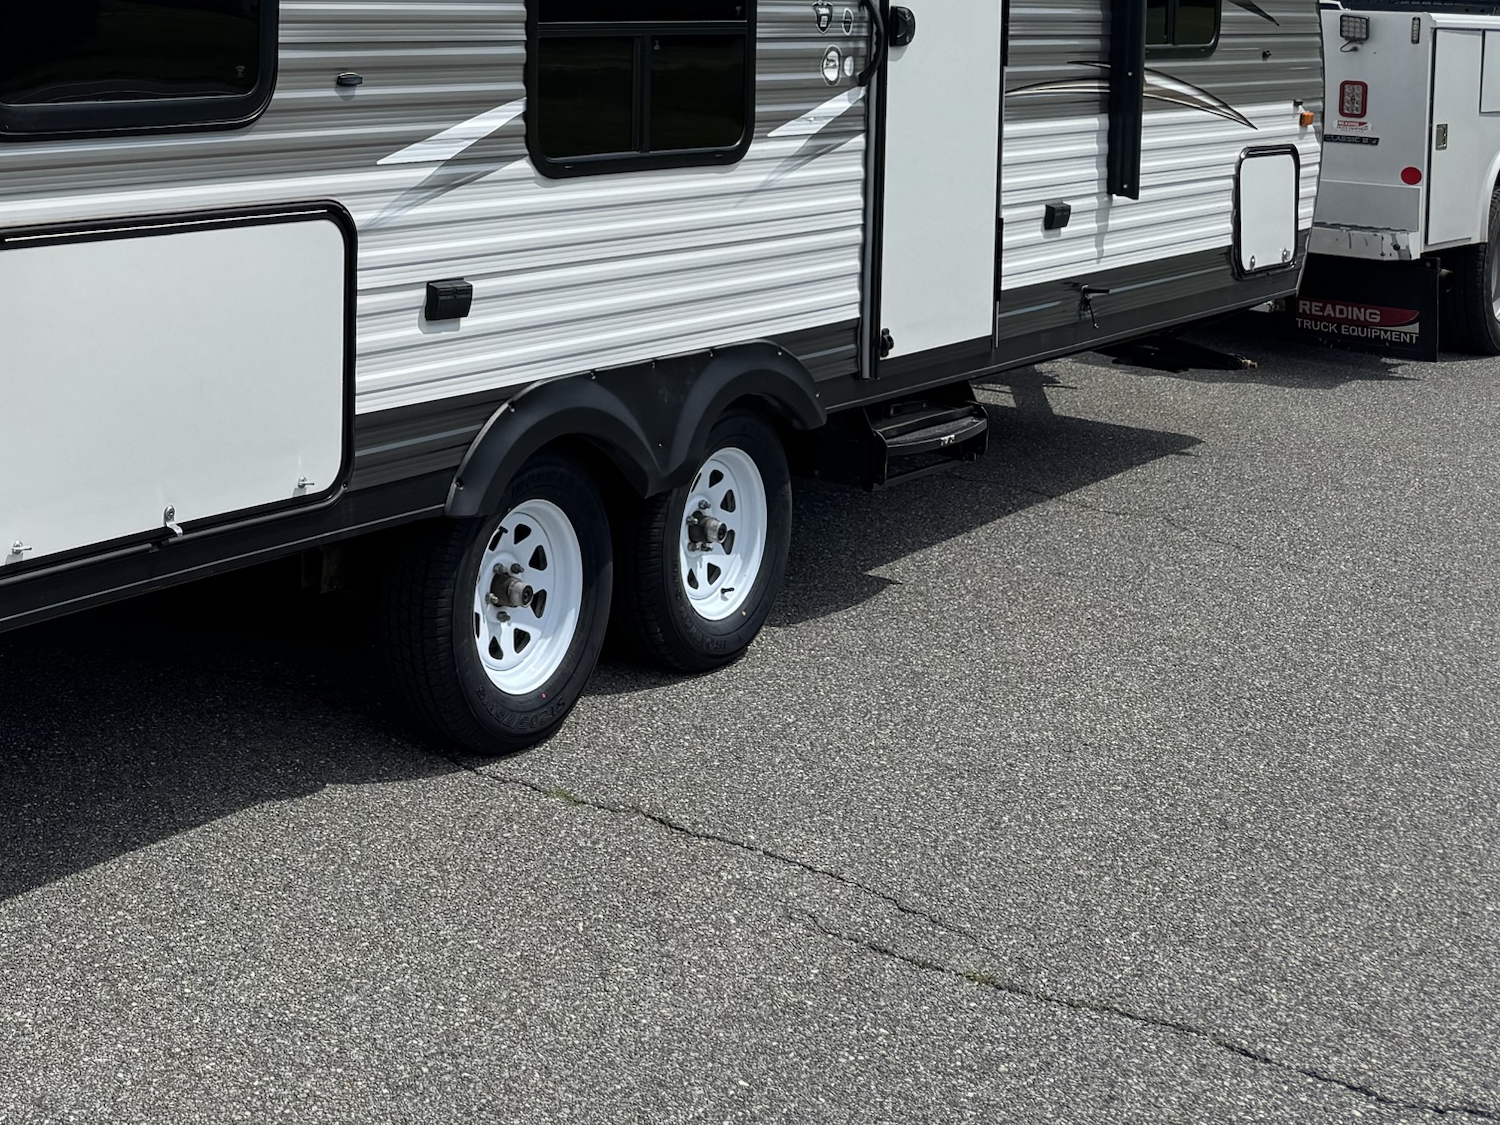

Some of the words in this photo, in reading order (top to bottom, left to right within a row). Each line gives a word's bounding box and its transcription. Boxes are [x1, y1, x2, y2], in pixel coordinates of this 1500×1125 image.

[1299, 300, 1381, 323] READING
[1296, 318, 1338, 333] TRUCK
[1341, 325, 1419, 344] EQUIPMENT
